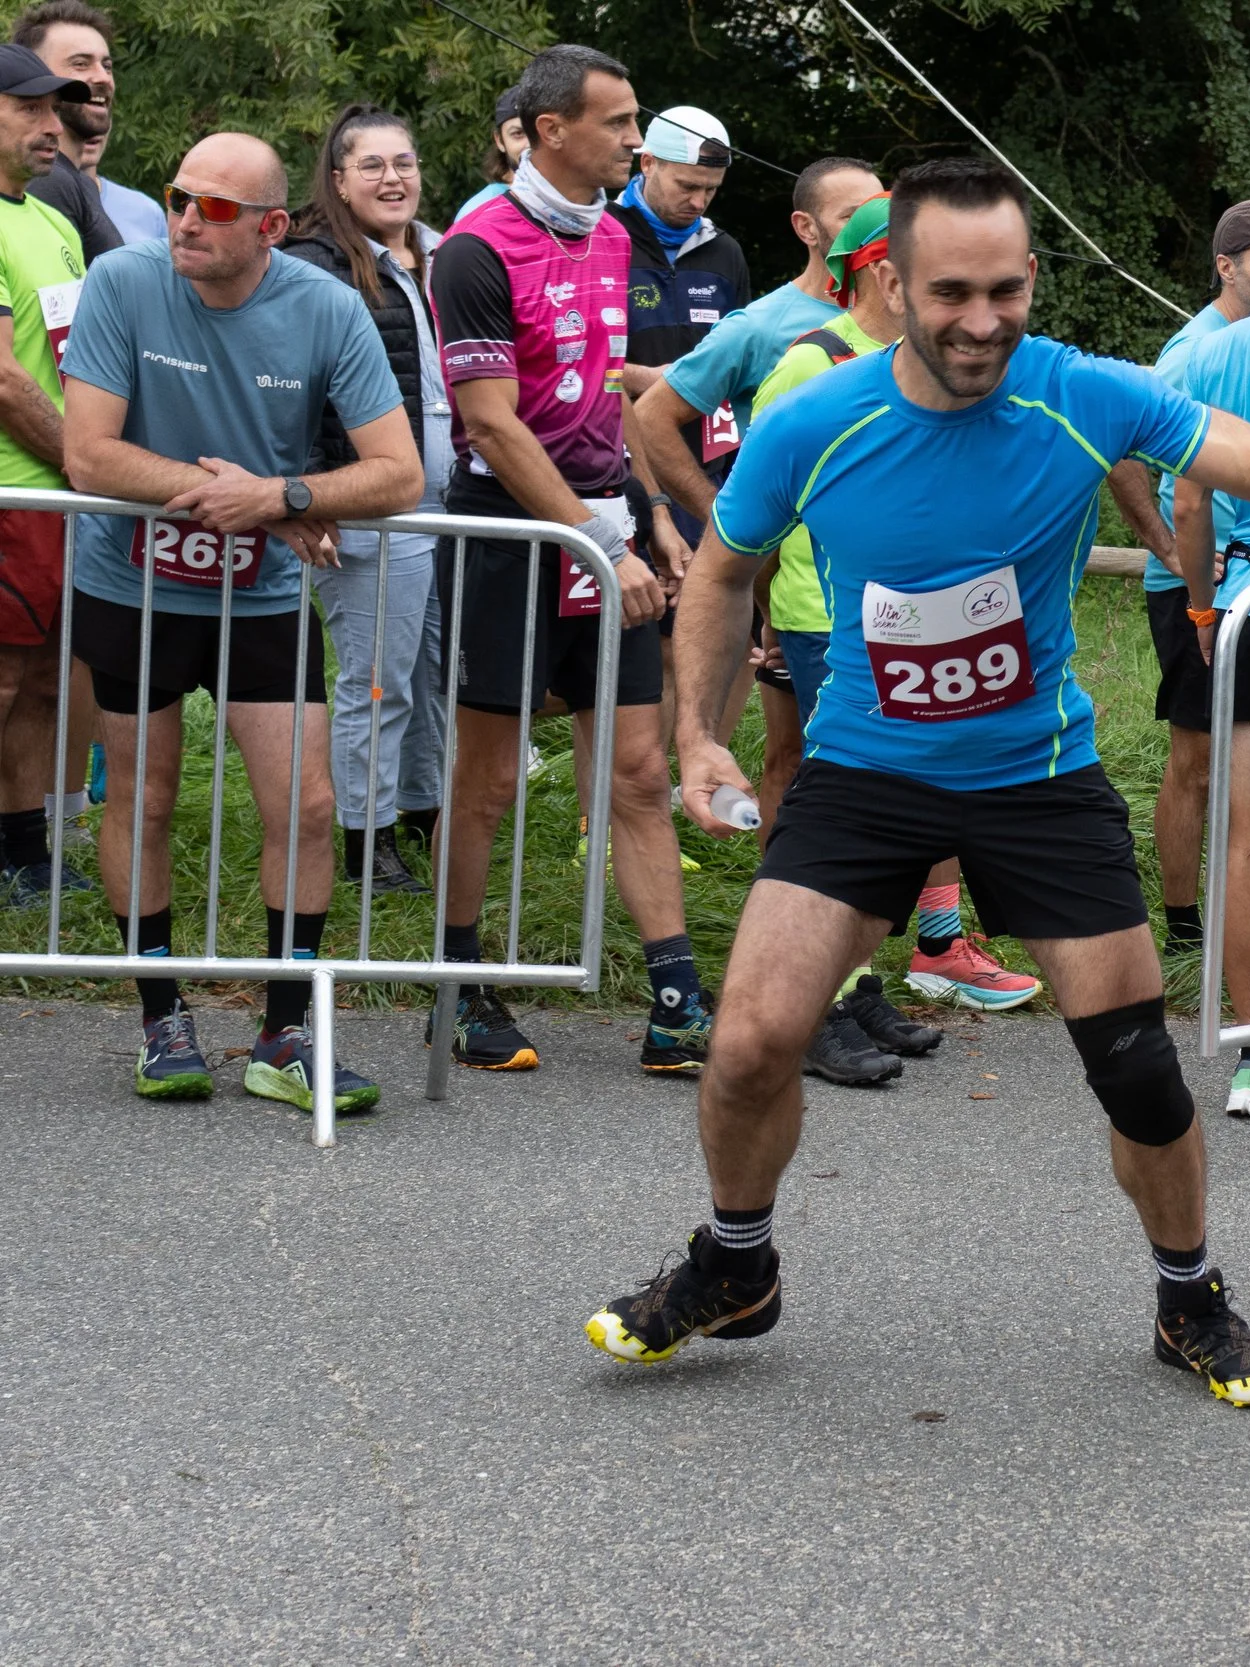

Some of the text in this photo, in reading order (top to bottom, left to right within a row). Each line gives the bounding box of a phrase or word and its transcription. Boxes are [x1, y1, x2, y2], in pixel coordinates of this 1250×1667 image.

[143, 350, 208, 373] FINISHERS
[274, 376, 302, 390] i-run
[141, 521, 257, 573] 265
[884, 643, 1020, 704] 289
